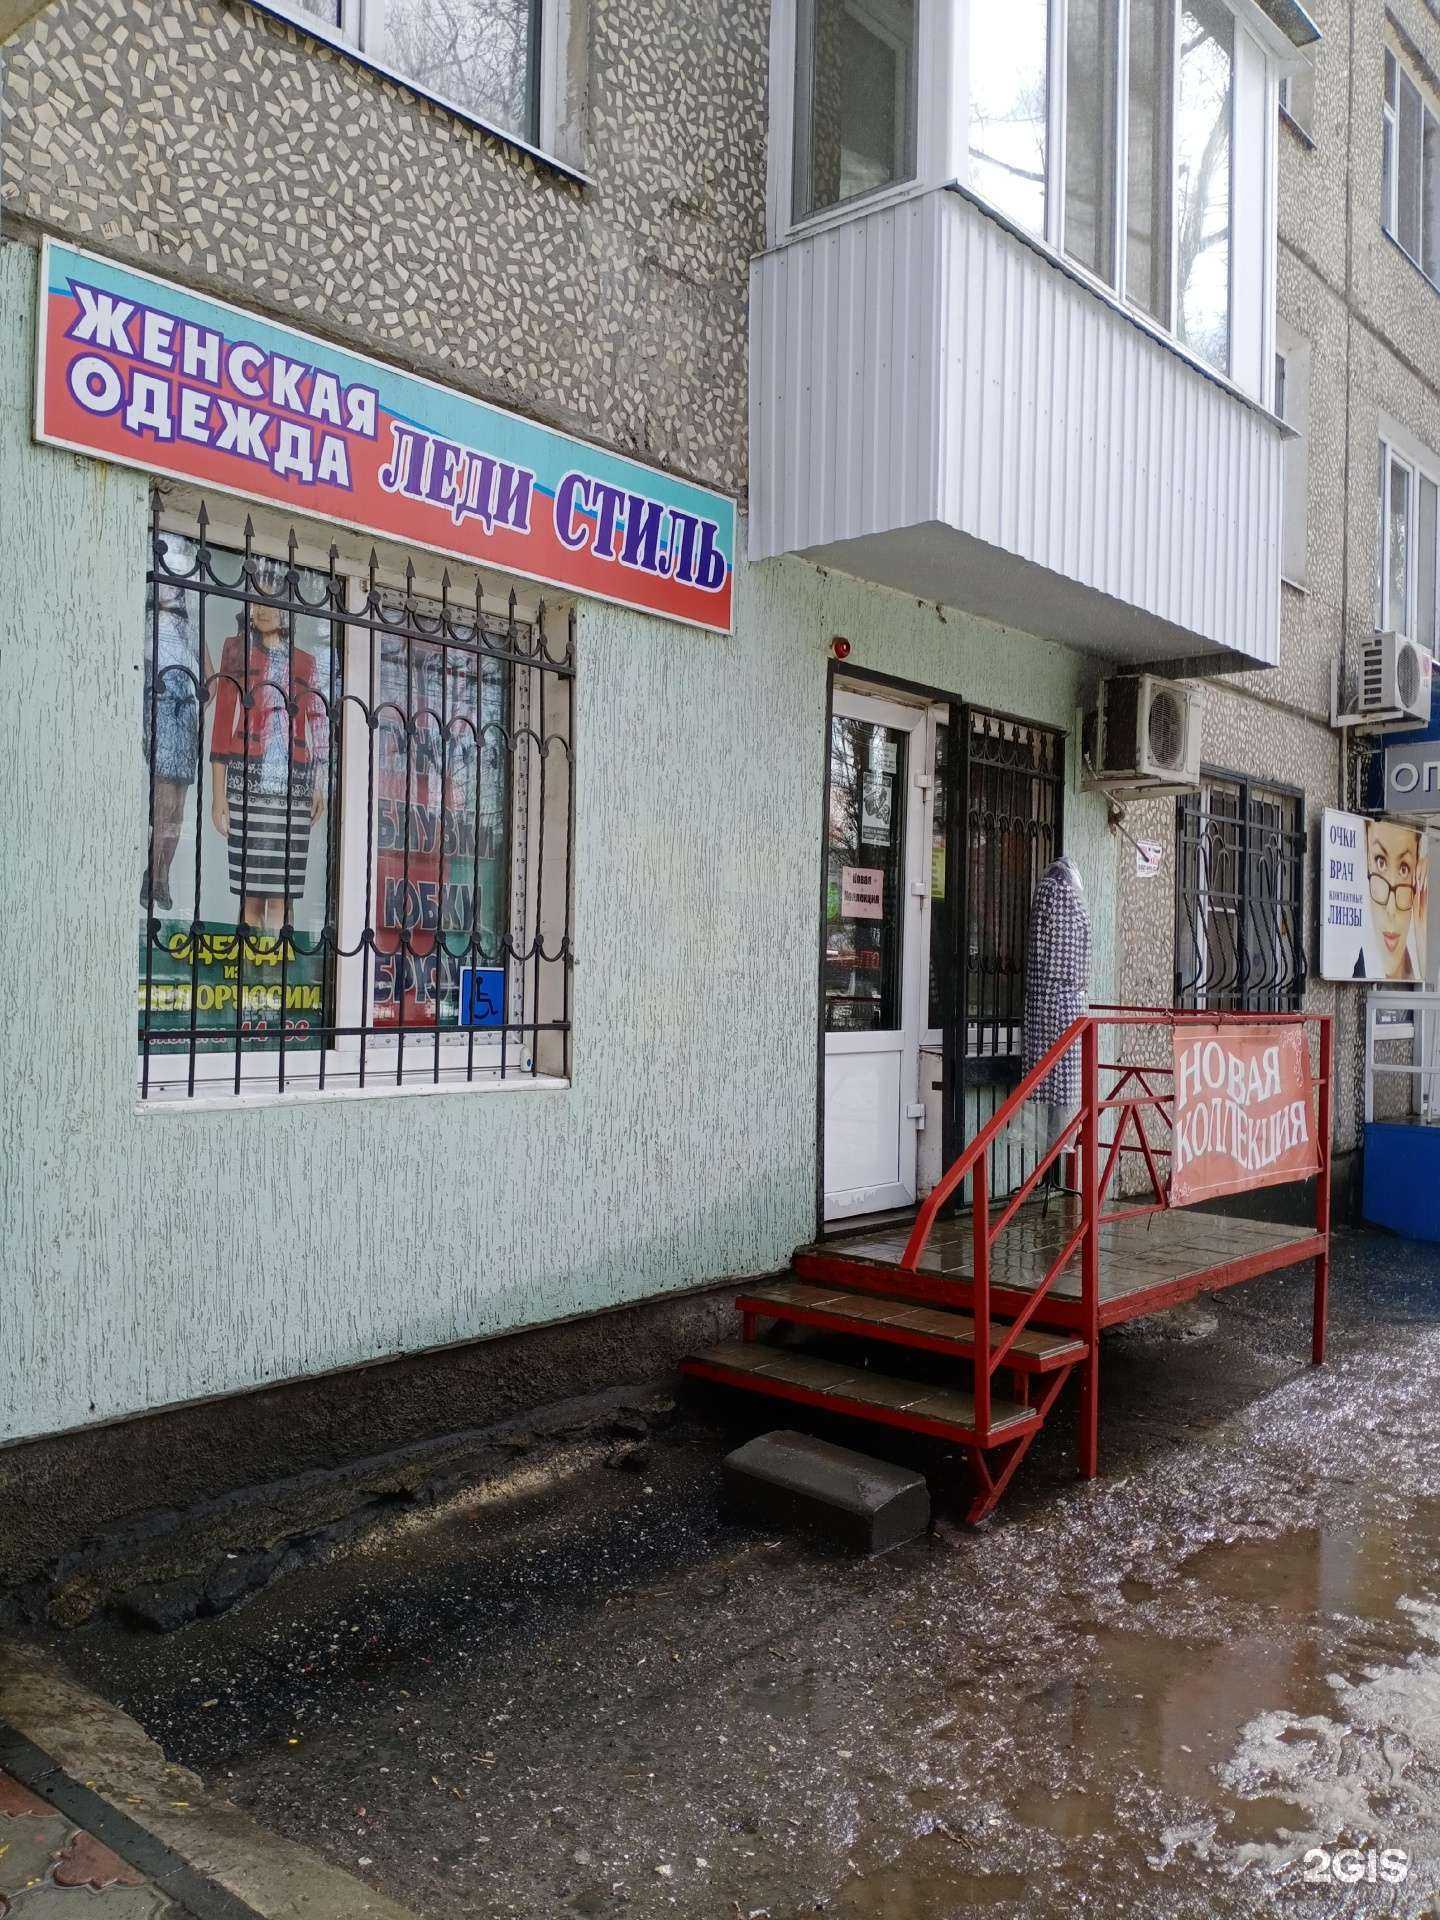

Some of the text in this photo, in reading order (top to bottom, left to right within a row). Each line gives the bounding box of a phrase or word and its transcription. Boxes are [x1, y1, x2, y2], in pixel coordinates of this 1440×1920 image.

[68, 280, 378, 438] ЖЕНСКАЯ
[68, 353, 351, 489] ОДЕЖДА
[379, 422, 728, 592] ЛЕДИ СТИЛЬ
[1329, 824, 1356, 849] ОЧКИ
[1329, 859, 1354, 883] ВРАЧ
[384, 876, 482, 932] ЮБКИ
[1327, 904, 1362, 928] ЛИНЗЫ
[374, 952, 492, 1004] БРЮ
[1178, 1041, 1282, 1110] НОВАЯ
[1176, 1097, 1309, 1173] КОЛЛЕКЦИЯ
